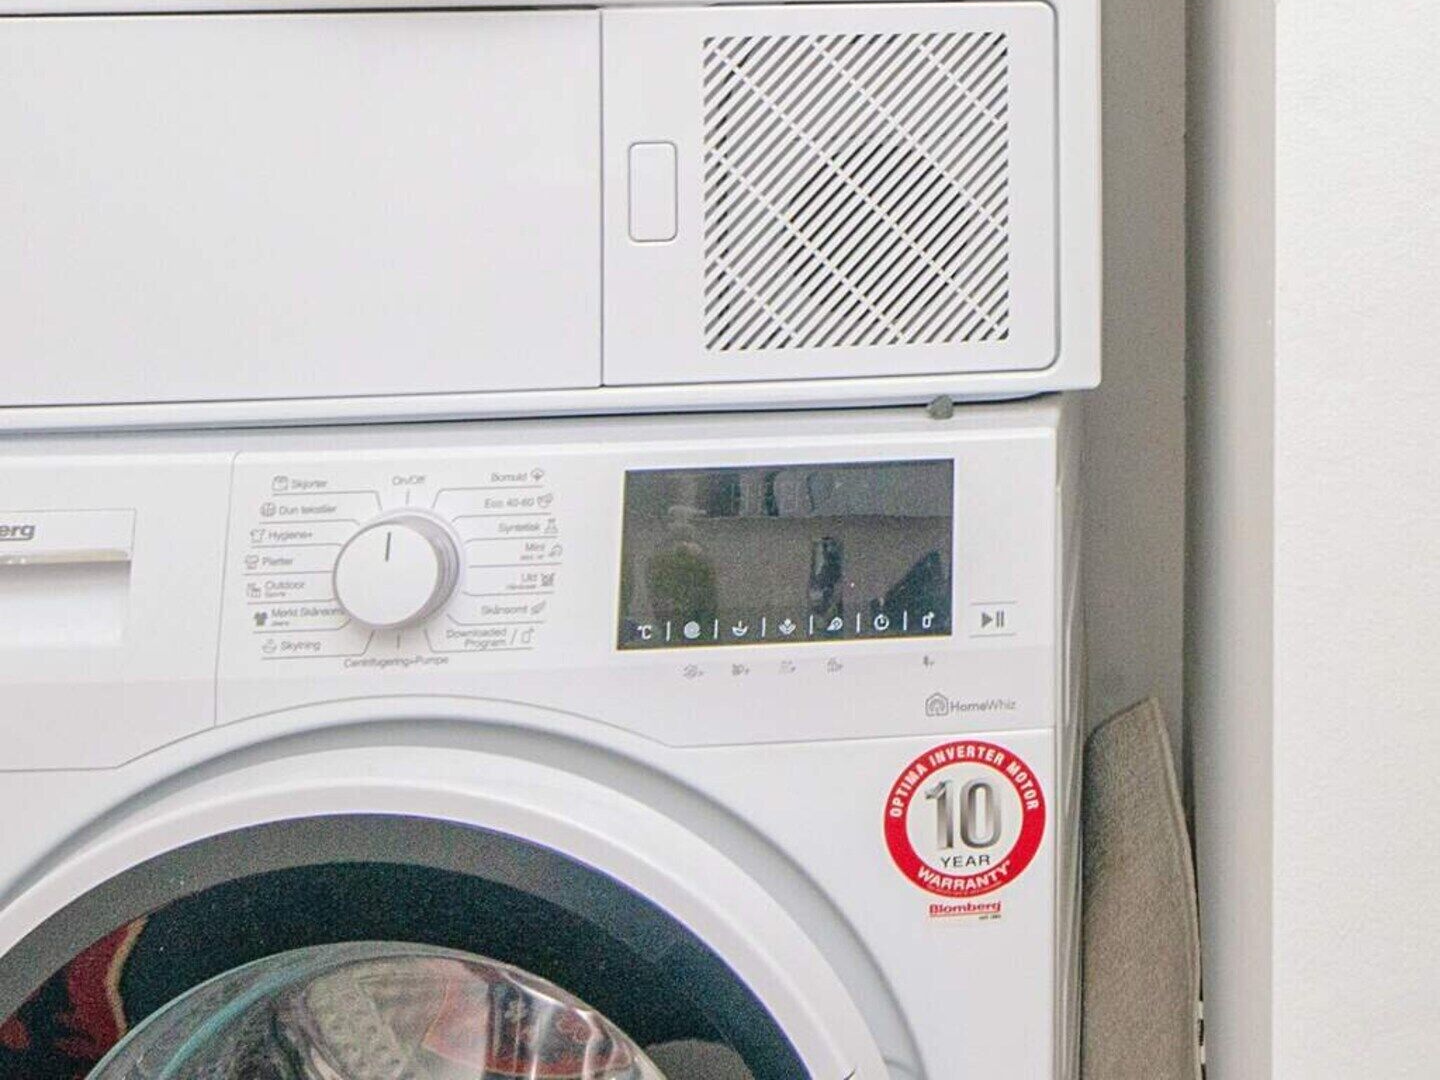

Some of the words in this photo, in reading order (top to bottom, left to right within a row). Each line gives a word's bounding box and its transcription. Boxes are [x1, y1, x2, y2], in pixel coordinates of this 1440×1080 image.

[279, 505, 299, 515] Dun
[447, 629, 507, 639] Downloaded
[464, 639, 507, 651] Program
[950, 699, 1017, 713] HomeWhiz
[889, 763, 928, 818] OPTIMA
[928, 745, 1005, 767] INVERTER
[1005, 760, 1040, 811] MOTOR
[924, 779, 1002, 850] 10
[940, 854, 991, 869] YEAR
[929, 900, 1002, 916] Blomberg
